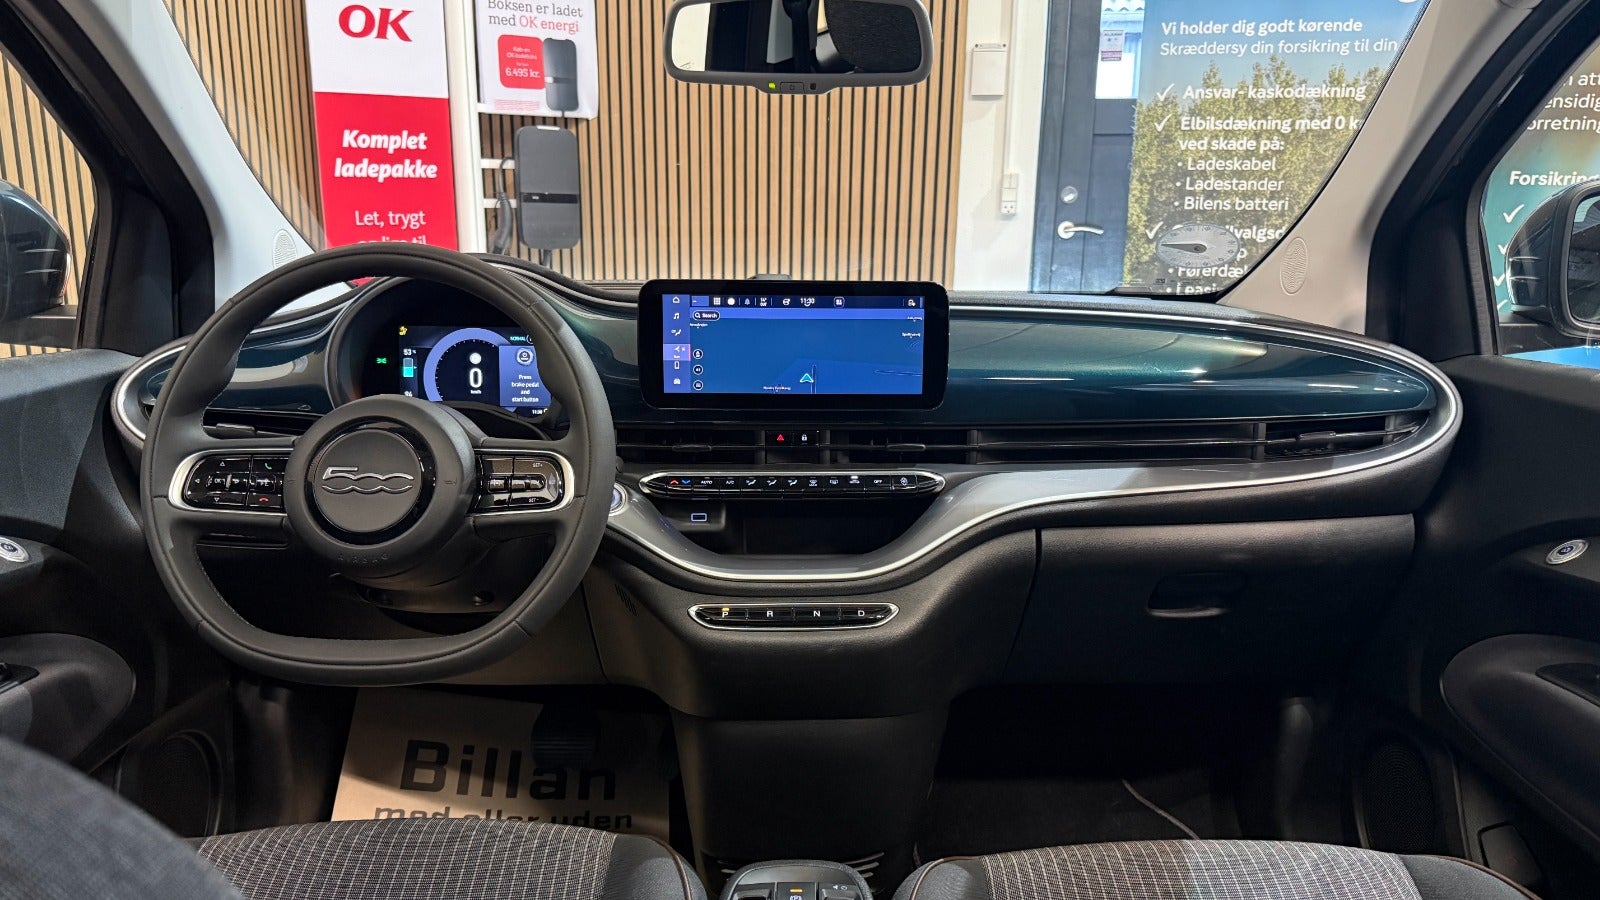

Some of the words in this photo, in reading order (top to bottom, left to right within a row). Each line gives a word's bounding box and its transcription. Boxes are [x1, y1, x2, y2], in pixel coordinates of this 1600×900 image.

[488, 0, 532, 13] Boksen
[536, 5, 549, 14] er
[552, 4, 583, 18] ladet
[339, 4, 414, 42] OK
[489, 15, 516, 26] med
[519, 16, 538, 28] OK
[541, 20, 579, 34] energi
[1161, 23, 1177, 35] Vi
[1180, 22, 1228, 35] holder
[1232, 22, 1254, 36] dig
[1258, 20, 1295, 36] godt
[1299, 18, 1363, 32] kørende
[1160, 42, 1247, 57] Skræddersy
[1251, 41, 1274, 54] din
[1278, 40, 1350, 55] forsikring
[1354, 39, 1369, 52] til
[1373, 38, 1398, 52] din
[505, 67, 529, 77] 6.495
[1183, 85, 1244, 99] Ansvar-
[1248, 84, 1367, 101] kaskodækning
[1180, 116, 1292, 133] Elbilsdækning
[1296, 117, 1332, 130] med
[1335, 116, 1346, 129] 0
[342, 129, 428, 154] Komplet
[1179, 137, 1208, 150] ved
[1211, 137, 1256, 150] skade
[1260, 136, 1285, 154] på:
[334, 157, 438, 183] ladepakke
[1187, 157, 1277, 170] Ladeskabel
[1185, 177, 1284, 191] Ladestander
[1184, 196, 1231, 210] Bilens
[1235, 197, 1289, 211] batteri
[355, 210, 384, 228] Let,
[388, 211, 427, 230] trygt
[469, 367, 483, 388] 0
[766, 610, 774, 618] R
[400, 739, 616, 801] Billan
